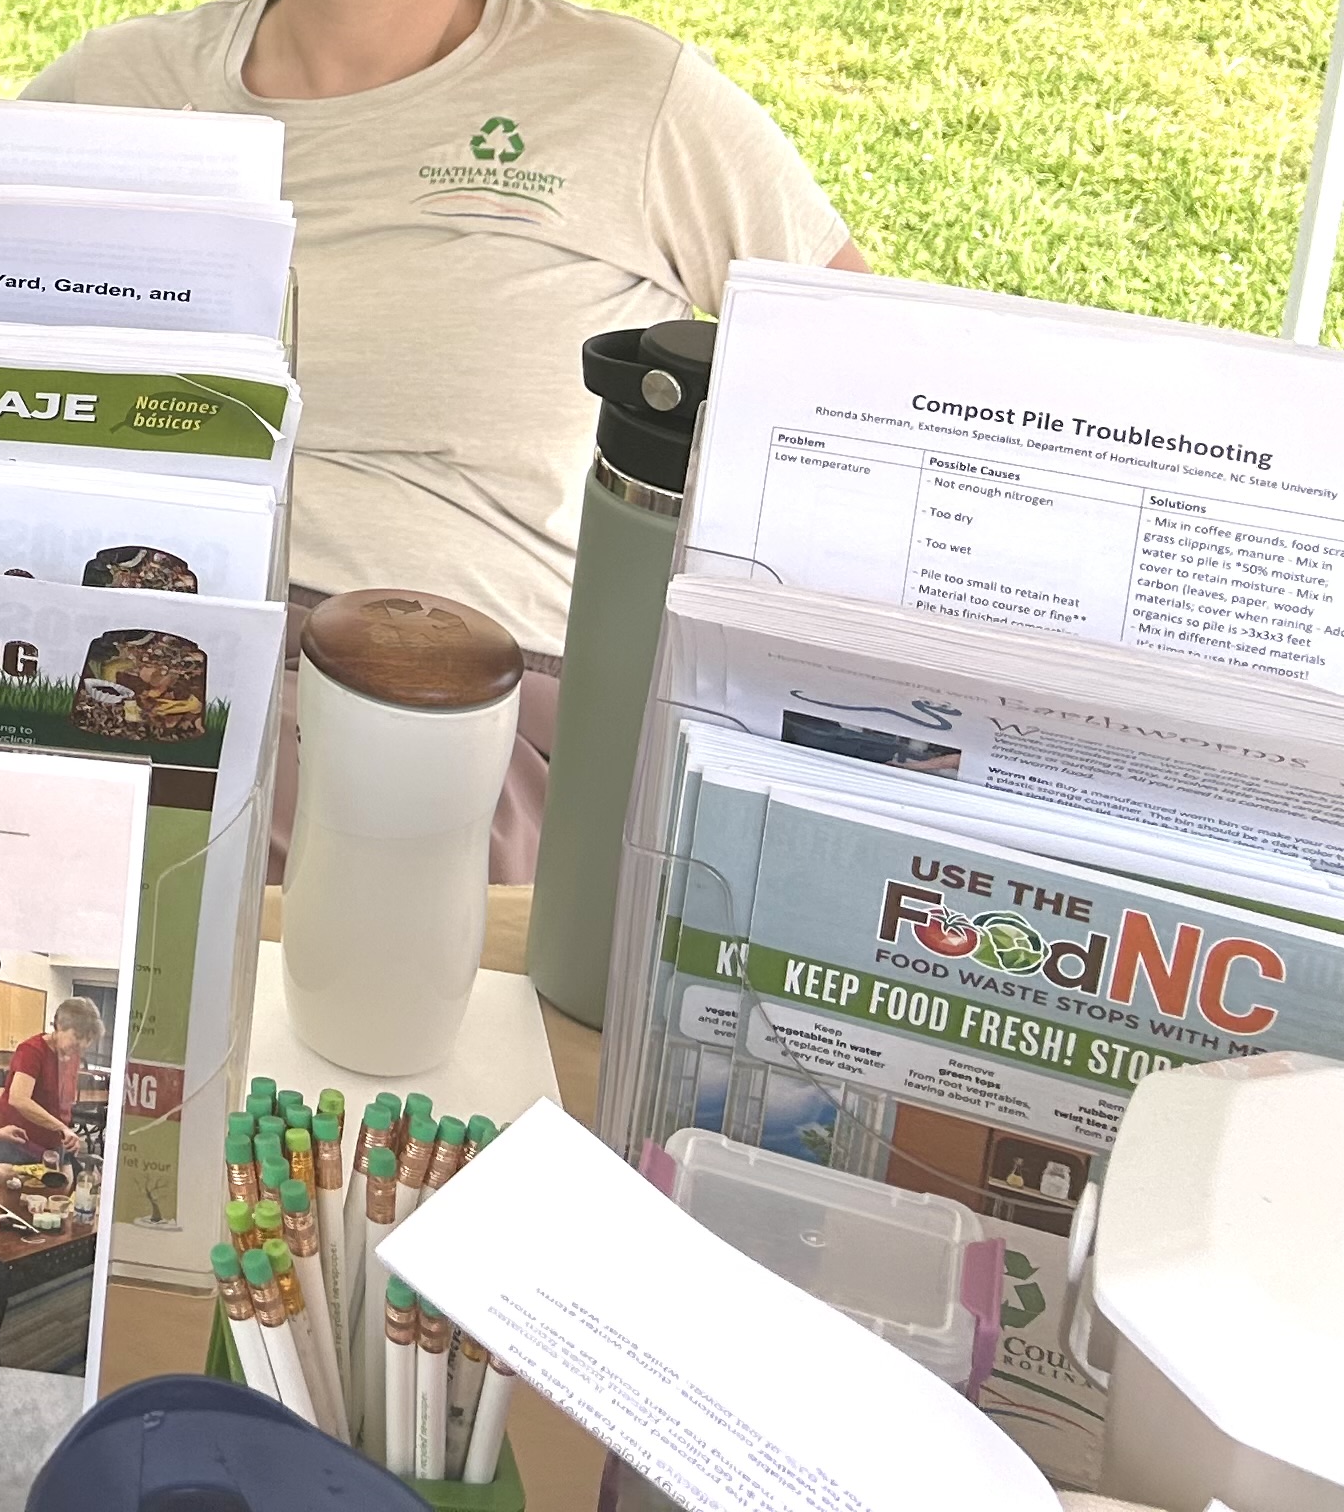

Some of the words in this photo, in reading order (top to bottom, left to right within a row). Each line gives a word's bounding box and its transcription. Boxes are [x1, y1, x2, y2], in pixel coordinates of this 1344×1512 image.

[419, 166, 497, 179] CHATHAM
[503, 167, 566, 188] COUNTY
[54, 279, 142, 300] Garden,
[149, 290, 191, 302] and
[136, 396, 218, 414] Nociones
[134, 413, 201, 430] básicas
[911, 394, 1015, 425] Compost
[1022, 410, 1064, 433] Pile
[1072, 418, 1274, 471] Troubleshooting
[777, 433, 826, 449] Problem
[775, 451, 798, 463] Low
[800, 454, 871, 475] temperature
[929, 457, 978, 474] Possible
[980, 466, 1020, 481] Causes
[1150, 495, 1207, 514] Solutions
[911, 855, 994, 897] USE
[1007, 879, 1093, 923] THE
[875, 949, 949, 979] FOOD
[958, 969, 1047, 1006] WASTE
[1056, 996, 1139, 1029] STOPS
[1149, 1019, 1219, 1050] WITH
[783, 959, 860, 1007] KEEP
[867, 981, 951, 1032] FOOD
[960, 1004, 1078, 1065] FRESH!
